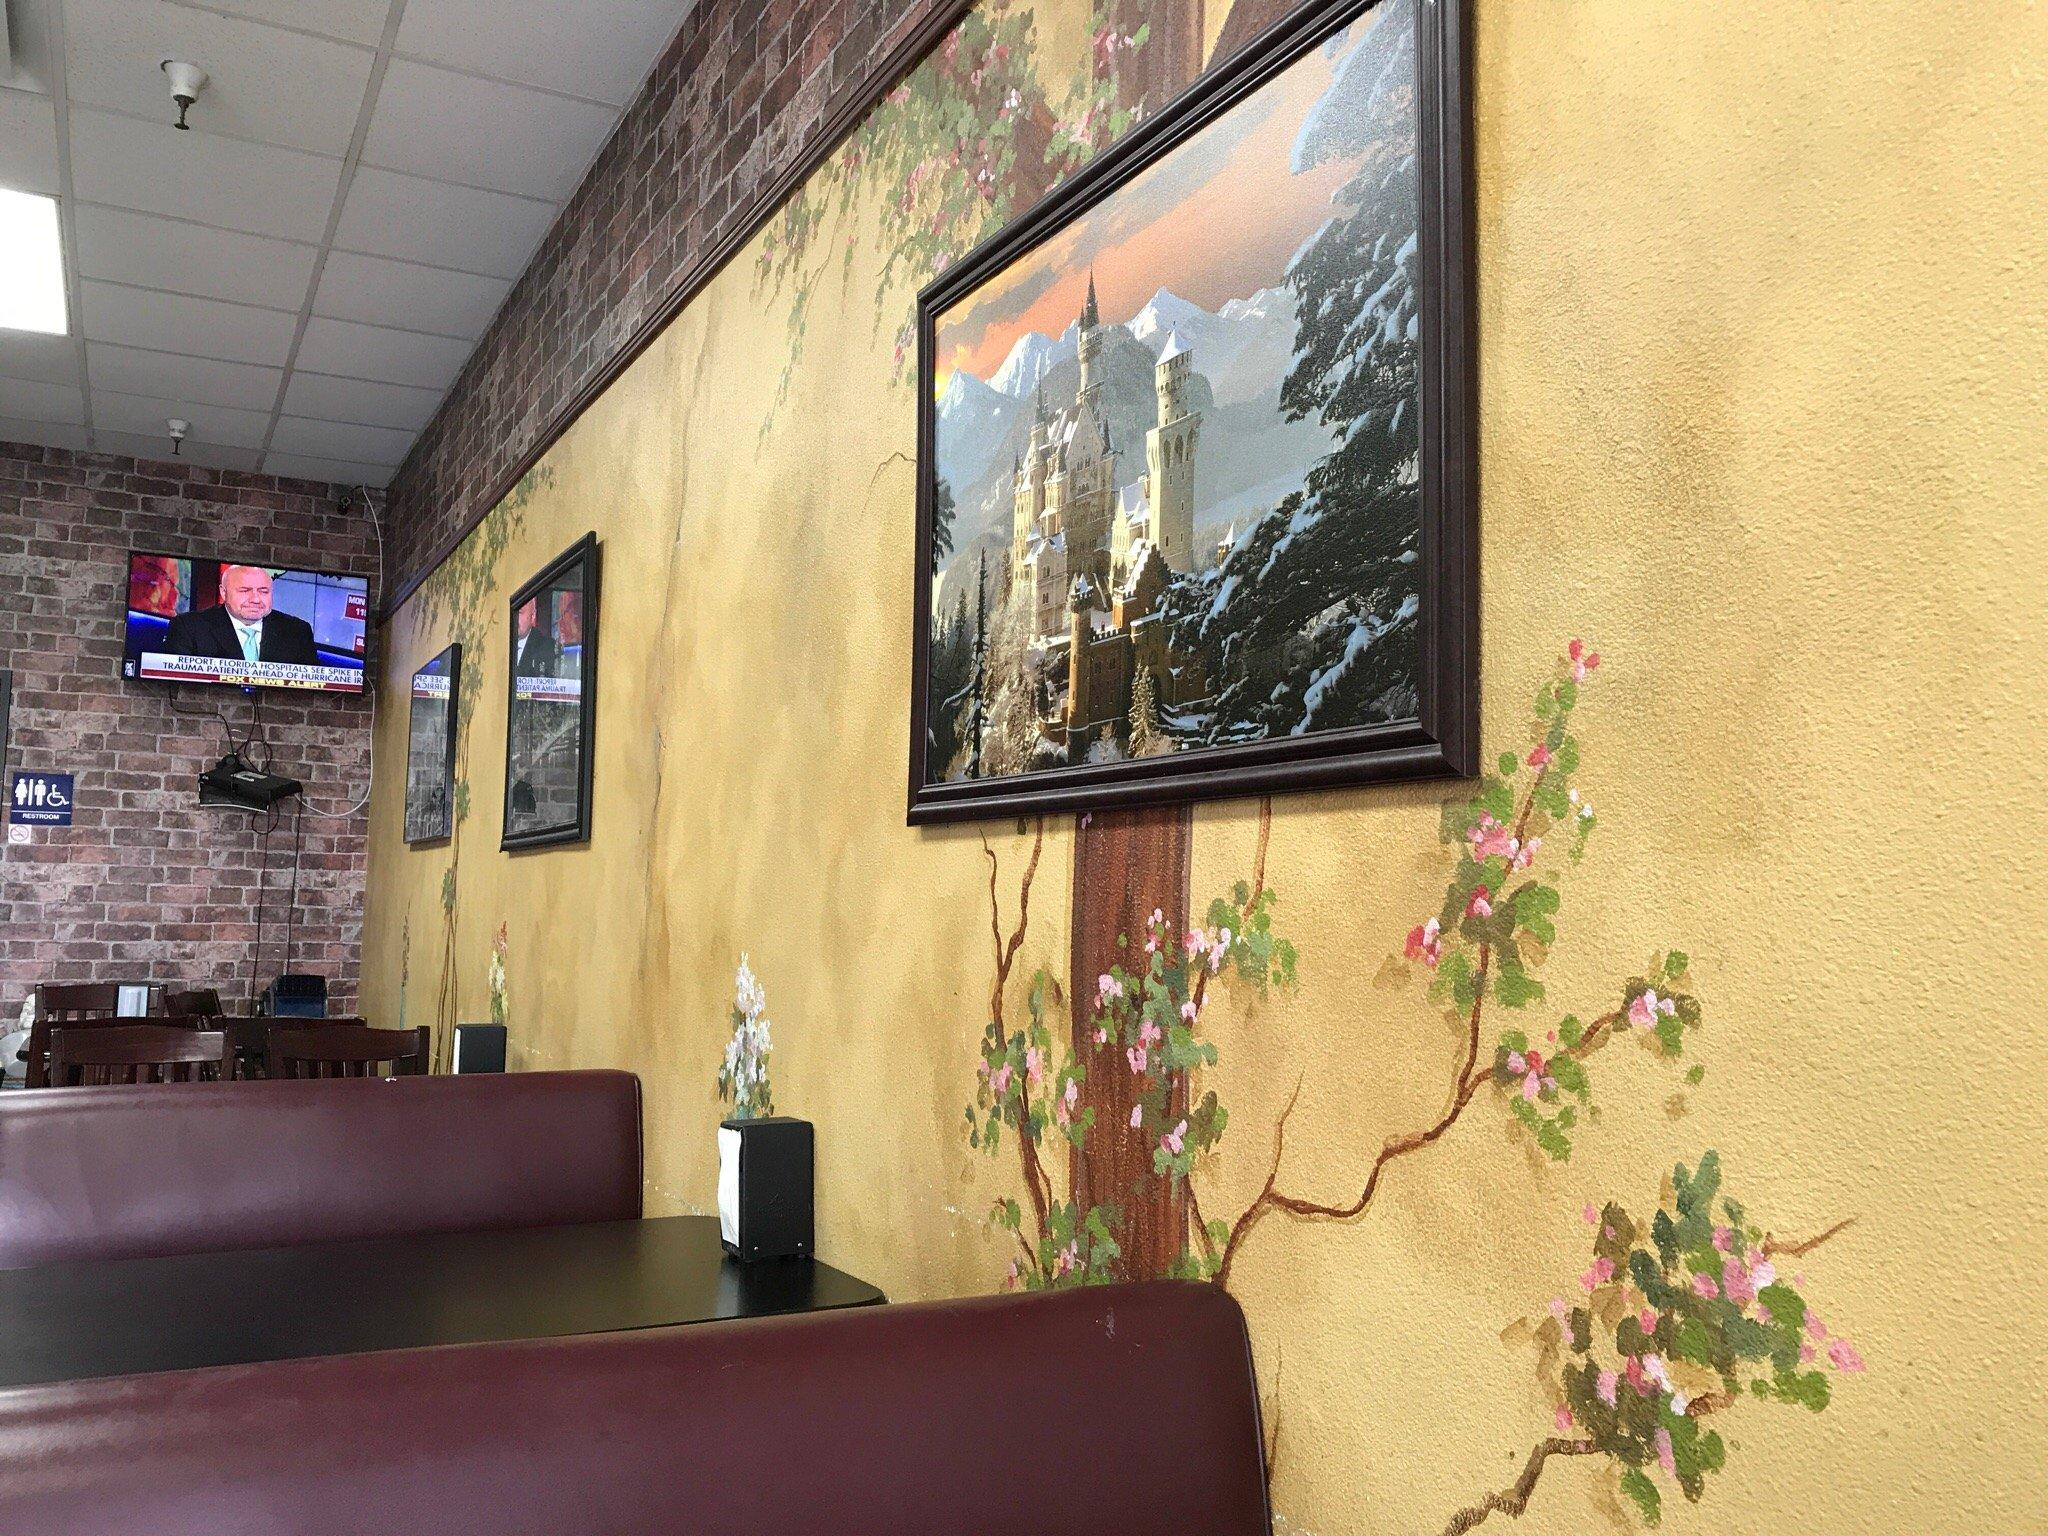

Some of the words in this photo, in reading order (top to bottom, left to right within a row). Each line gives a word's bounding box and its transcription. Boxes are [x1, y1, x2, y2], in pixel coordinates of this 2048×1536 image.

[348, 596, 366, 606] MON
[163, 662, 204, 672] TRAUMA
[207, 665, 250, 675] PATIENTS
[252, 669, 284, 679] AHEAD
[301, 673, 351, 683] HURRICANE
[178, 656, 215, 666] REPORT:
[220, 659, 258, 669] FLORIDA
[260, 662, 308, 673] HOSPITALS
[311, 666, 326, 674] SEE
[328, 668, 351, 676] SPIKE
[219, 675, 245, 683] FOX
[249, 677, 285, 686] NEWS
[288, 680, 327, 689] ALERT
